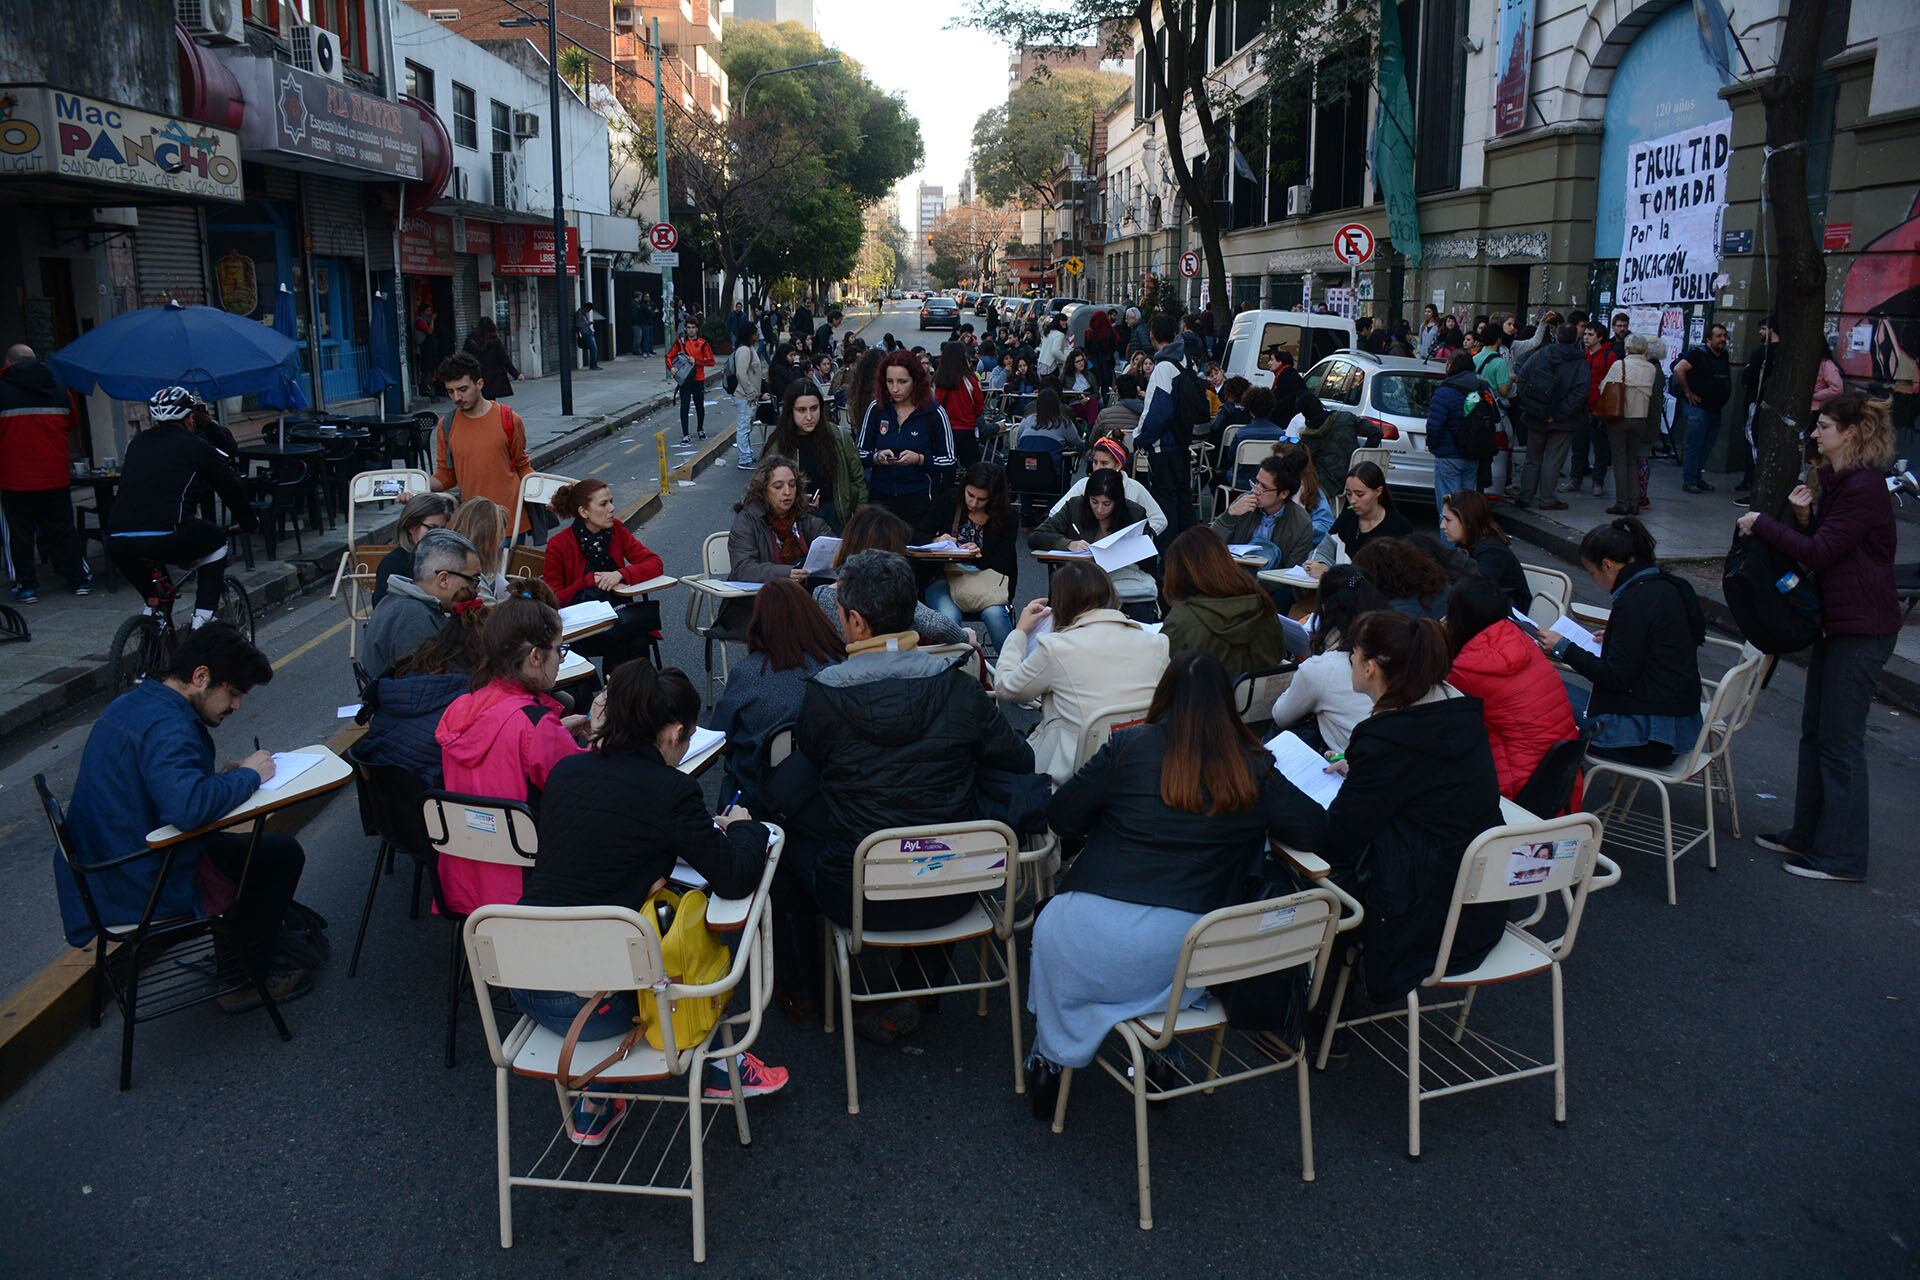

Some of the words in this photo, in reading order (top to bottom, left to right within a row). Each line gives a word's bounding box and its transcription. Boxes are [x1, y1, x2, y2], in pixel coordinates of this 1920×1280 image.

[55, 93, 122, 129] Mac
[309, 113, 349, 138] Especialidad
[1656, 102, 1670, 117] 120
[58, 122, 237, 184] PANCHO
[311, 136, 331, 152] FIESTAS
[335, 142, 356, 158] EVENTOS
[1634, 133, 1728, 188] FACULTAD
[1640, 174, 1715, 219] TOMADA
[1660, 218, 1669, 240] la
[1623, 244, 1688, 284] EDUCACIÓN
[1671, 268, 1719, 301] PÚBLIC
[904, 841, 921, 851] AyL
